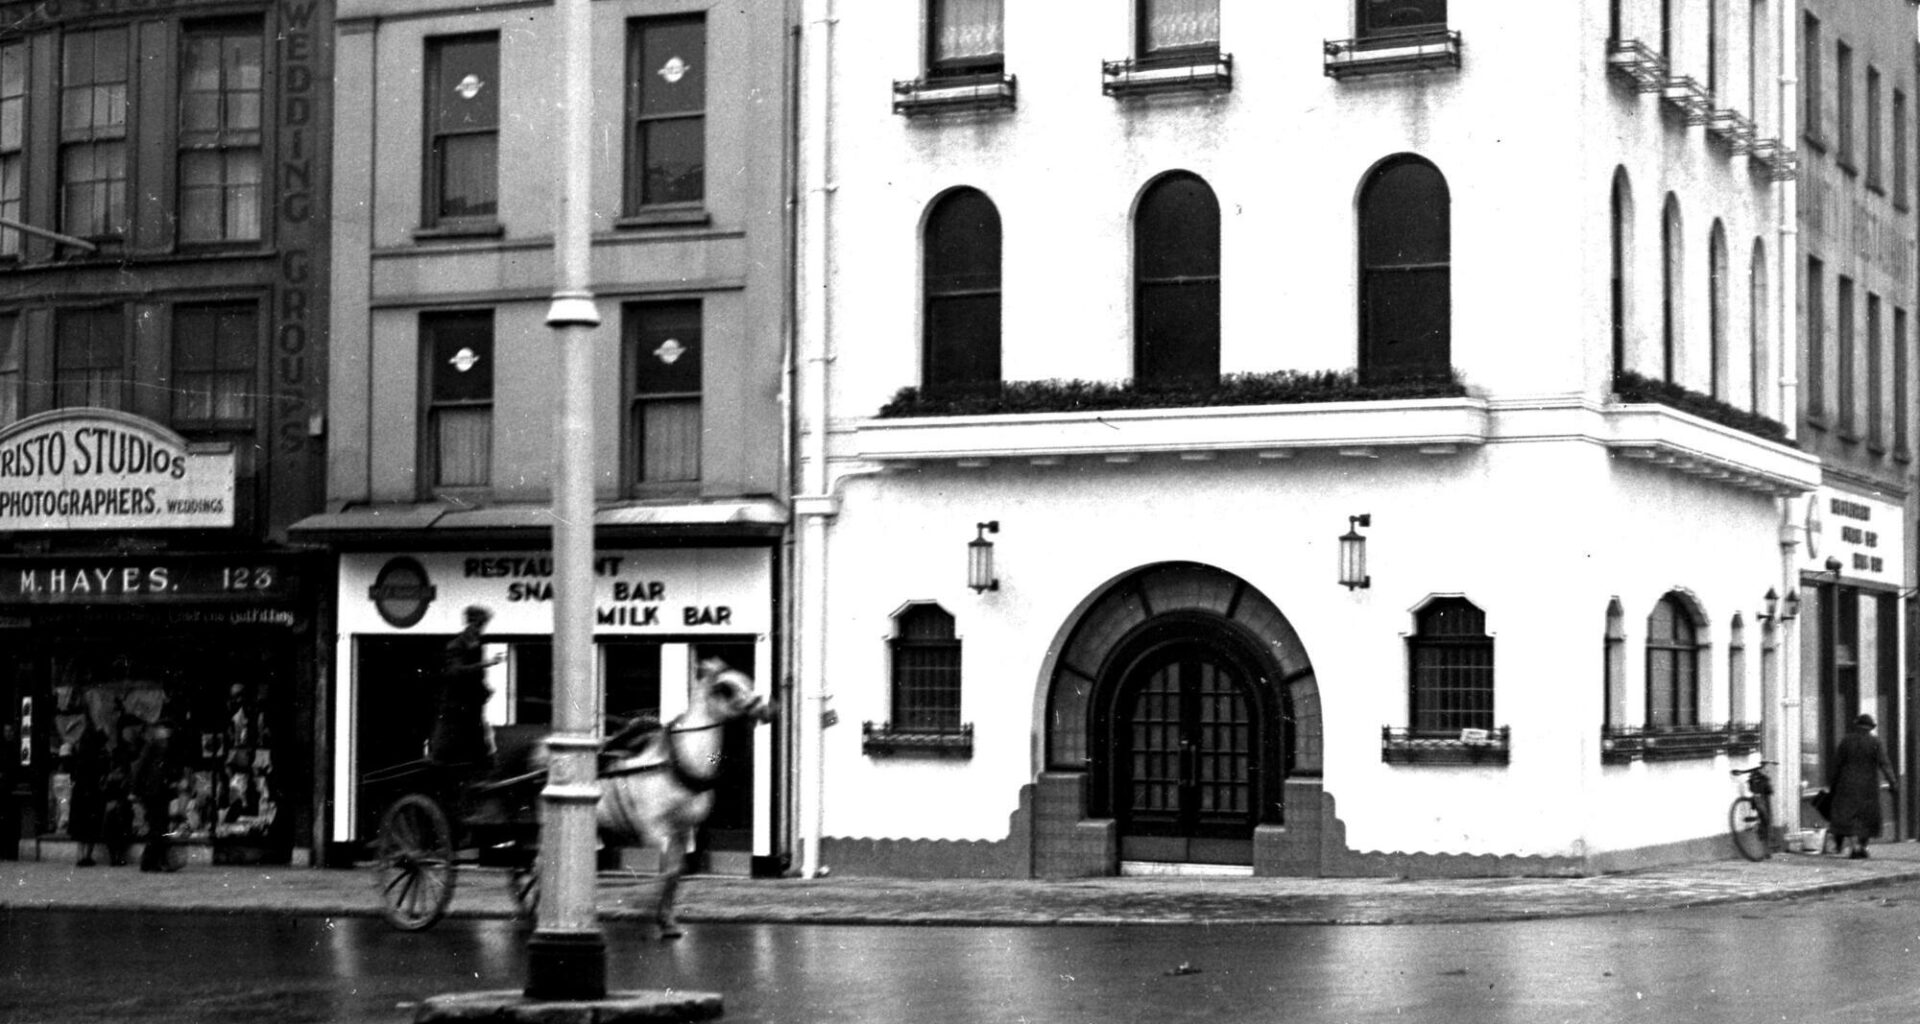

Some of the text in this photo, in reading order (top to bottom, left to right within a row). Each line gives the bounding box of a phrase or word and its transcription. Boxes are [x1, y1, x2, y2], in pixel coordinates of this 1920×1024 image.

[282, 0, 317, 224] WEDDING
[0, 431, 66, 477] RISTO
[464, 556, 624, 578] RESTAUNT
[222, 567, 273, 590] 123
[507, 581, 666, 602] SNA BAR
[597, 605, 732, 626] MILK BAR
